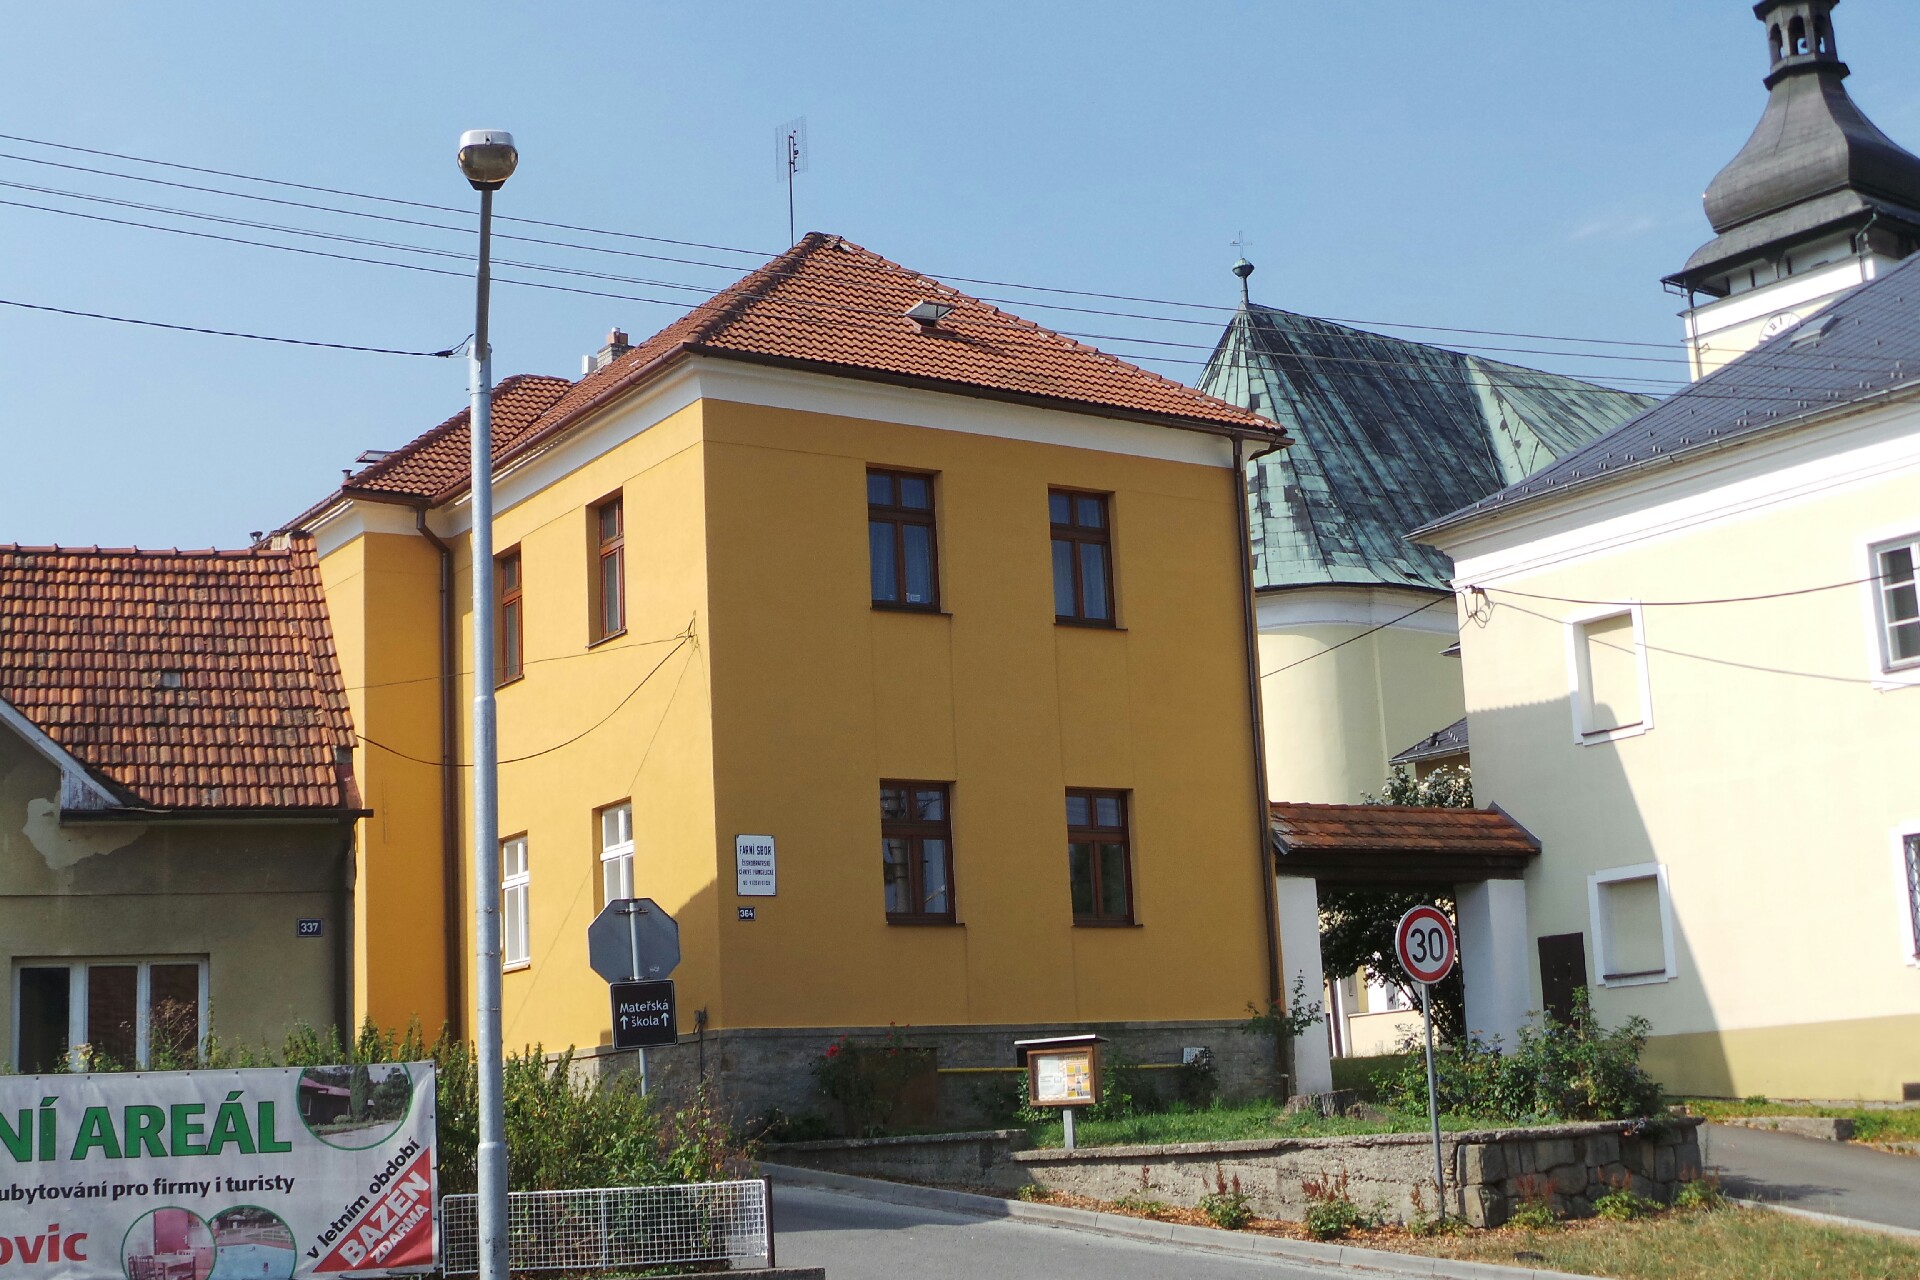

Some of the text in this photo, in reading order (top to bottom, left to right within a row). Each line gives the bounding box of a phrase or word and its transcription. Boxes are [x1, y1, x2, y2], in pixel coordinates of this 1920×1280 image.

[757, 845, 771, 855] SBOR
[300, 922, 319, 933] 337
[1410, 927, 1444, 964] 30
[619, 999, 669, 1014] Mateřská
[631, 1015, 660, 1028] škola
[70, 1090, 292, 1161] AREÁL
[0, 1175, 295, 1205] ubytování pro firmy i turisty
[306, 1136, 421, 1259] v letním období
[370, 1204, 430, 1264] ZDARMA
